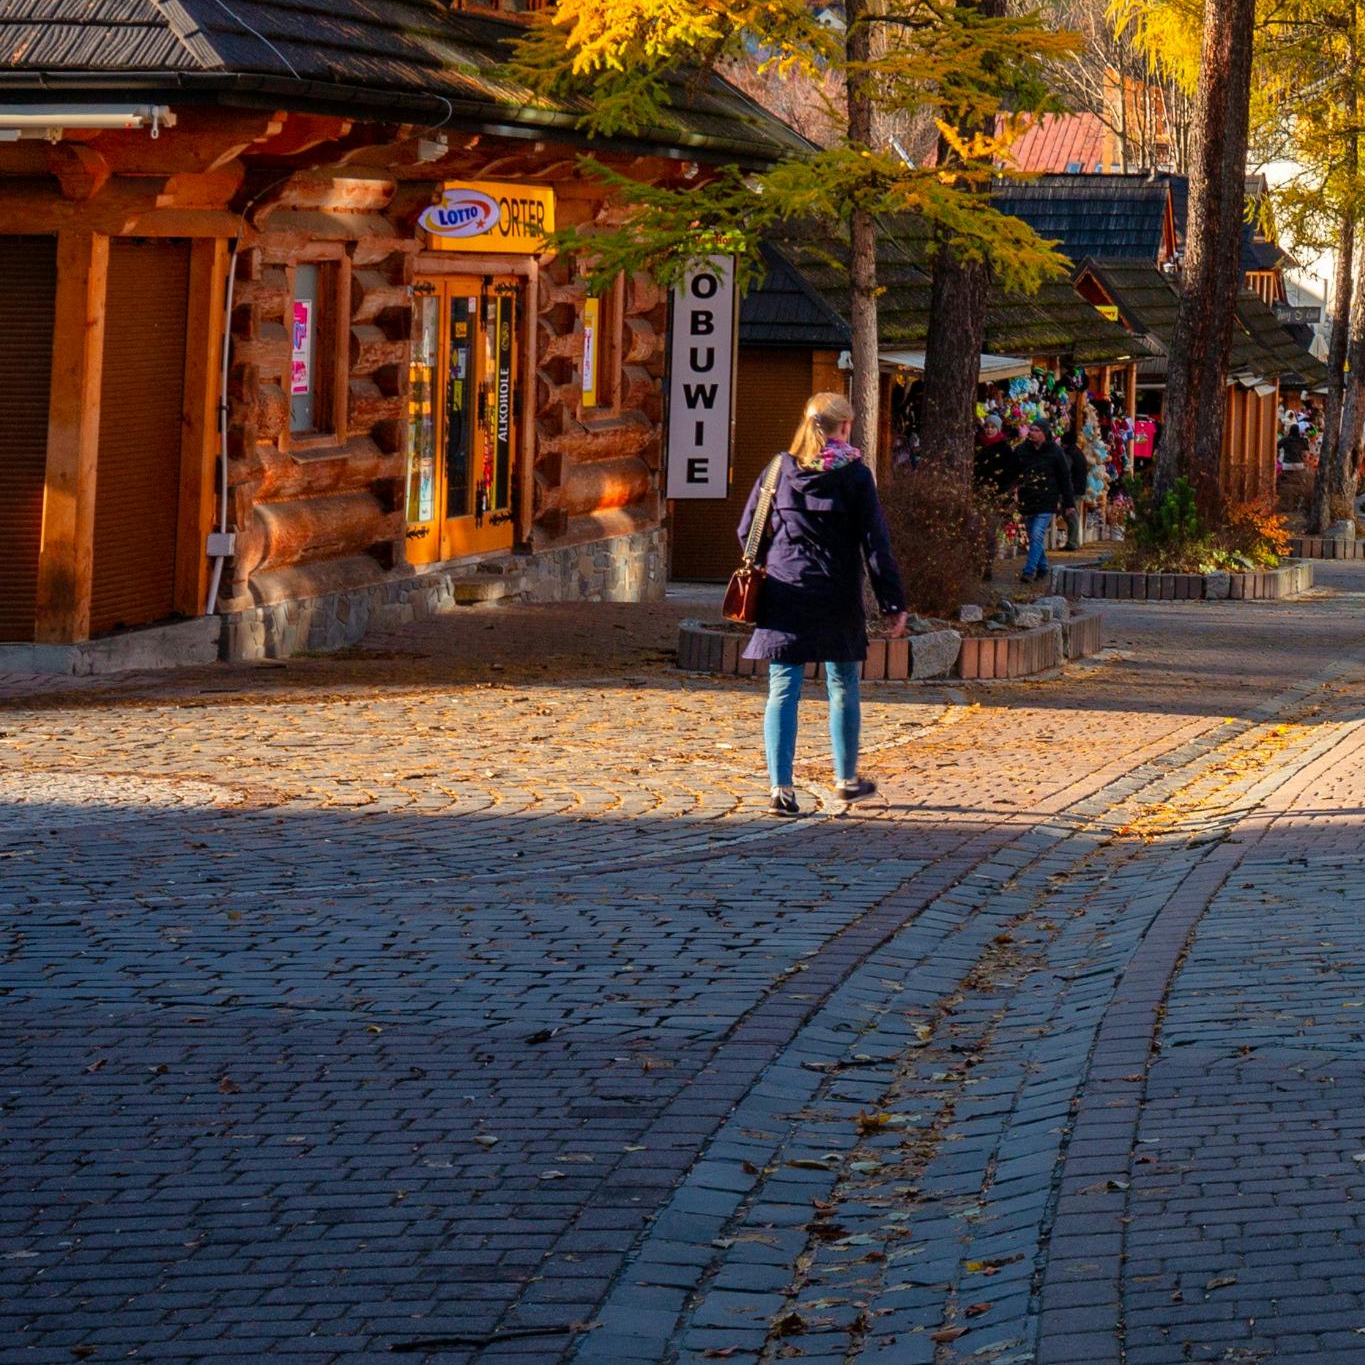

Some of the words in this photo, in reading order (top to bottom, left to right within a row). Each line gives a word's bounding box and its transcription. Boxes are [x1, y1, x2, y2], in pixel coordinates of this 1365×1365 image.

[438, 206, 478, 226] LOTTO
[497, 367, 510, 443] ALKOHOLE
[682, 272, 720, 485] OBUWIE
